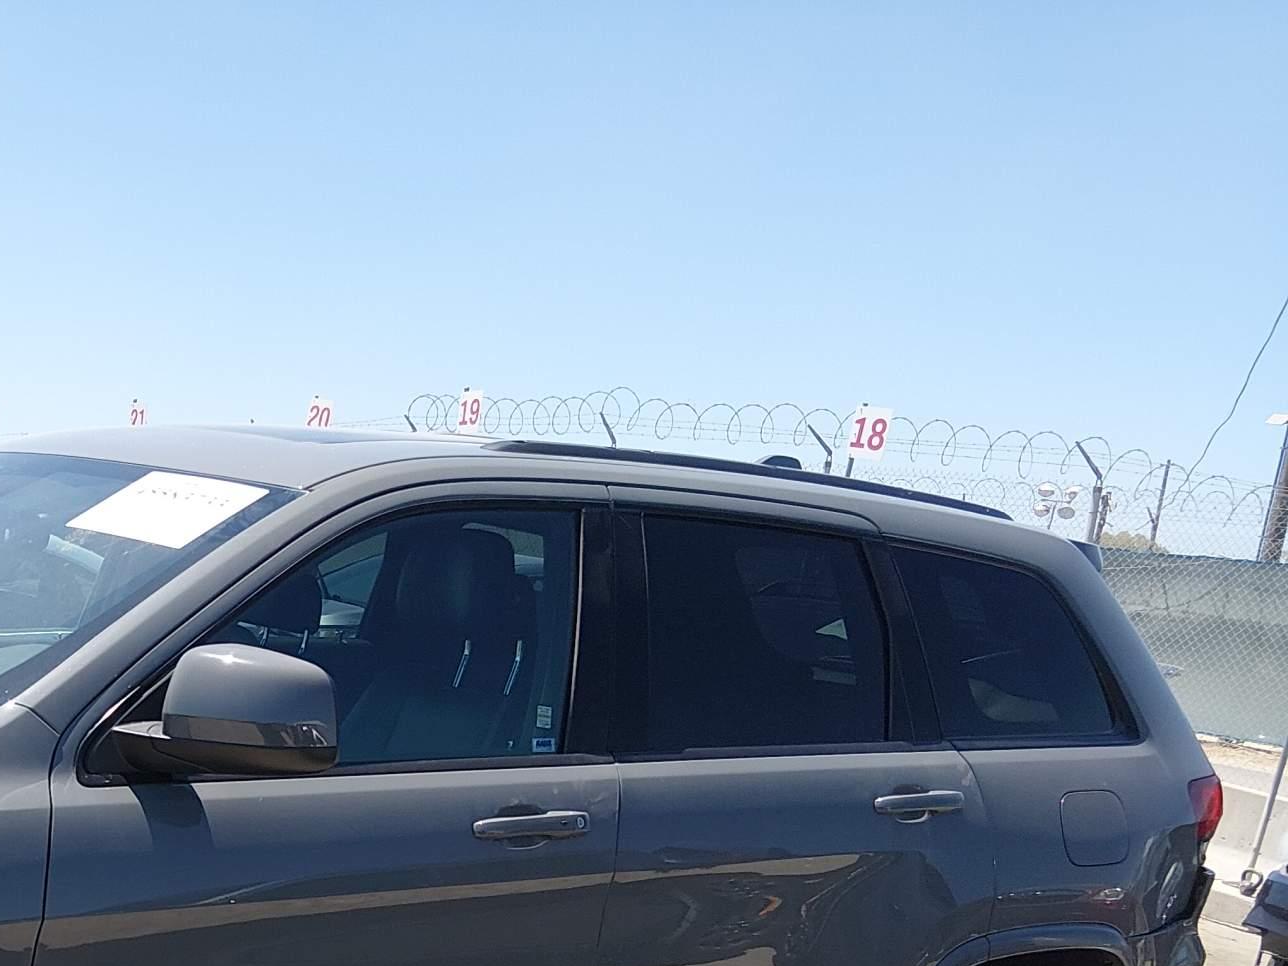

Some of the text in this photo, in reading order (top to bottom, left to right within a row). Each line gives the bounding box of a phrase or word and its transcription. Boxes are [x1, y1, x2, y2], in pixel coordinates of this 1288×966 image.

[131, 408, 145, 425] 21
[307, 405, 331, 428] 20
[459, 398, 481, 425] 19
[849, 416, 888, 451] 18
